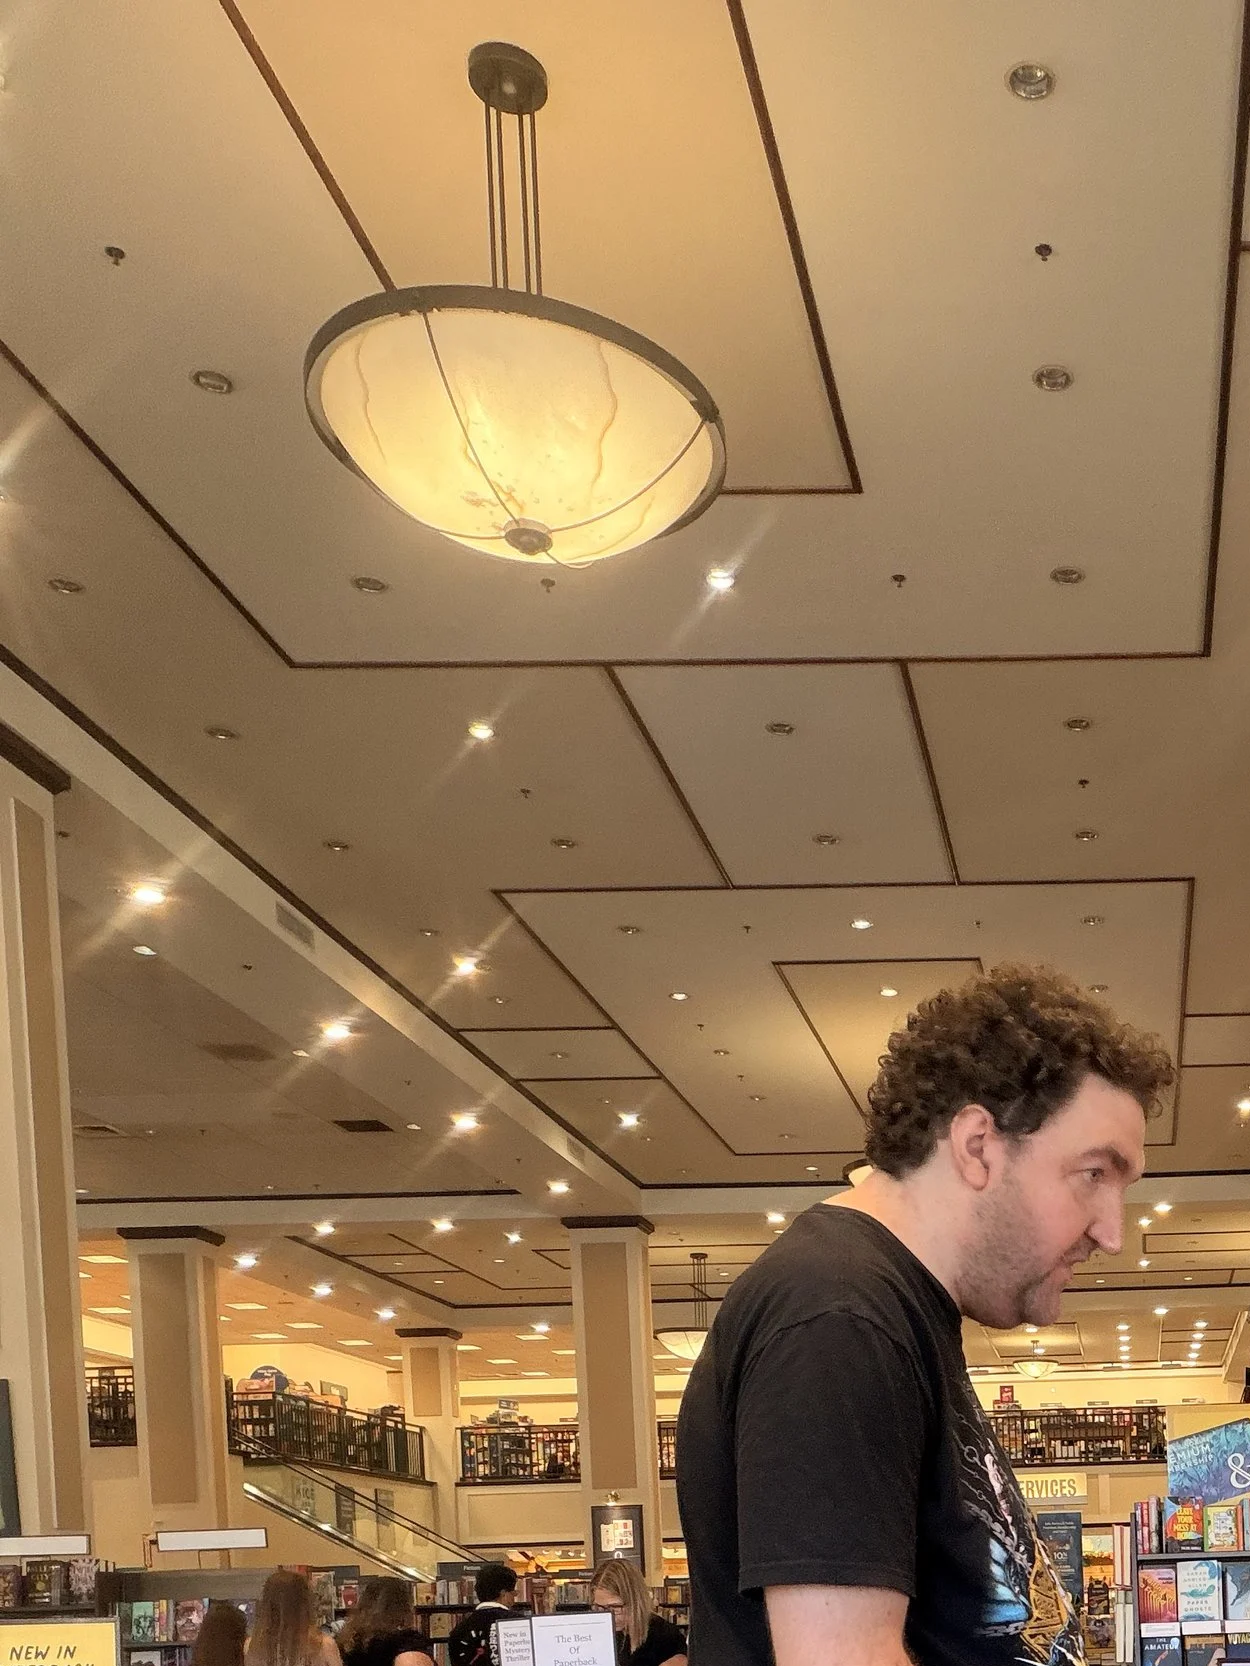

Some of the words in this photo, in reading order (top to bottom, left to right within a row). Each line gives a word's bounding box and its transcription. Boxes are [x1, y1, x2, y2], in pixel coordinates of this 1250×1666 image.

[1173, 1524, 1190, 1532] MESS
[555, 1634, 573, 1643] The
[574, 1633, 592, 1642] Best
[10, 1646, 50, 1661] NEW
[57, 1645, 77, 1660] IN
[569, 1646, 580, 1655] Of
[506, 1655, 530, 1663] Thriller
